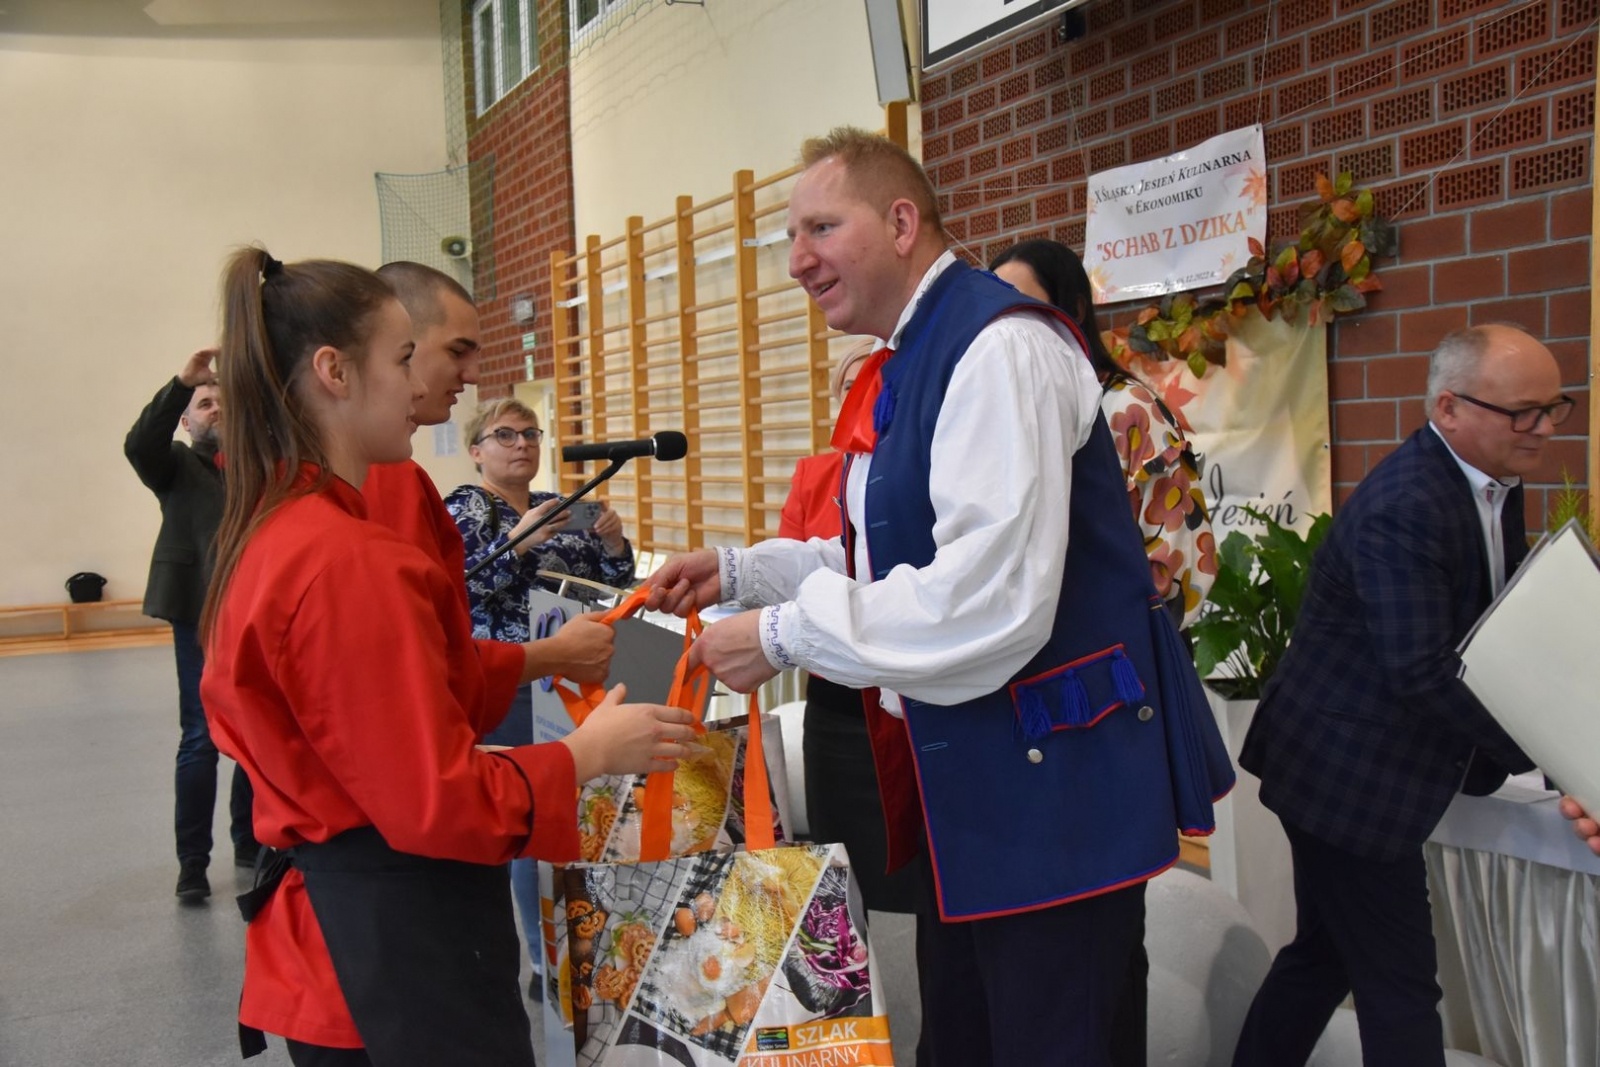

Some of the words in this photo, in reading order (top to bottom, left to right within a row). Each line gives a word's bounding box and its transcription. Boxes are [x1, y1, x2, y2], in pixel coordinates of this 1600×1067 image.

[1101, 185, 1136, 202] ŚLĄSKA
[1137, 171, 1175, 196] JESIEŃ
[1178, 150, 1252, 183] KULINARNA
[1136, 187, 1204, 215] EKONOMIKU
[1097, 231, 1161, 262] "SCHAB
[1163, 228, 1177, 249] Z
[1179, 208, 1253, 246] DZIKA"
[1207, 463, 1298, 526] Jesień
[796, 1020, 858, 1046] SZLAK
[746, 1045, 861, 1067] KULINARNY
